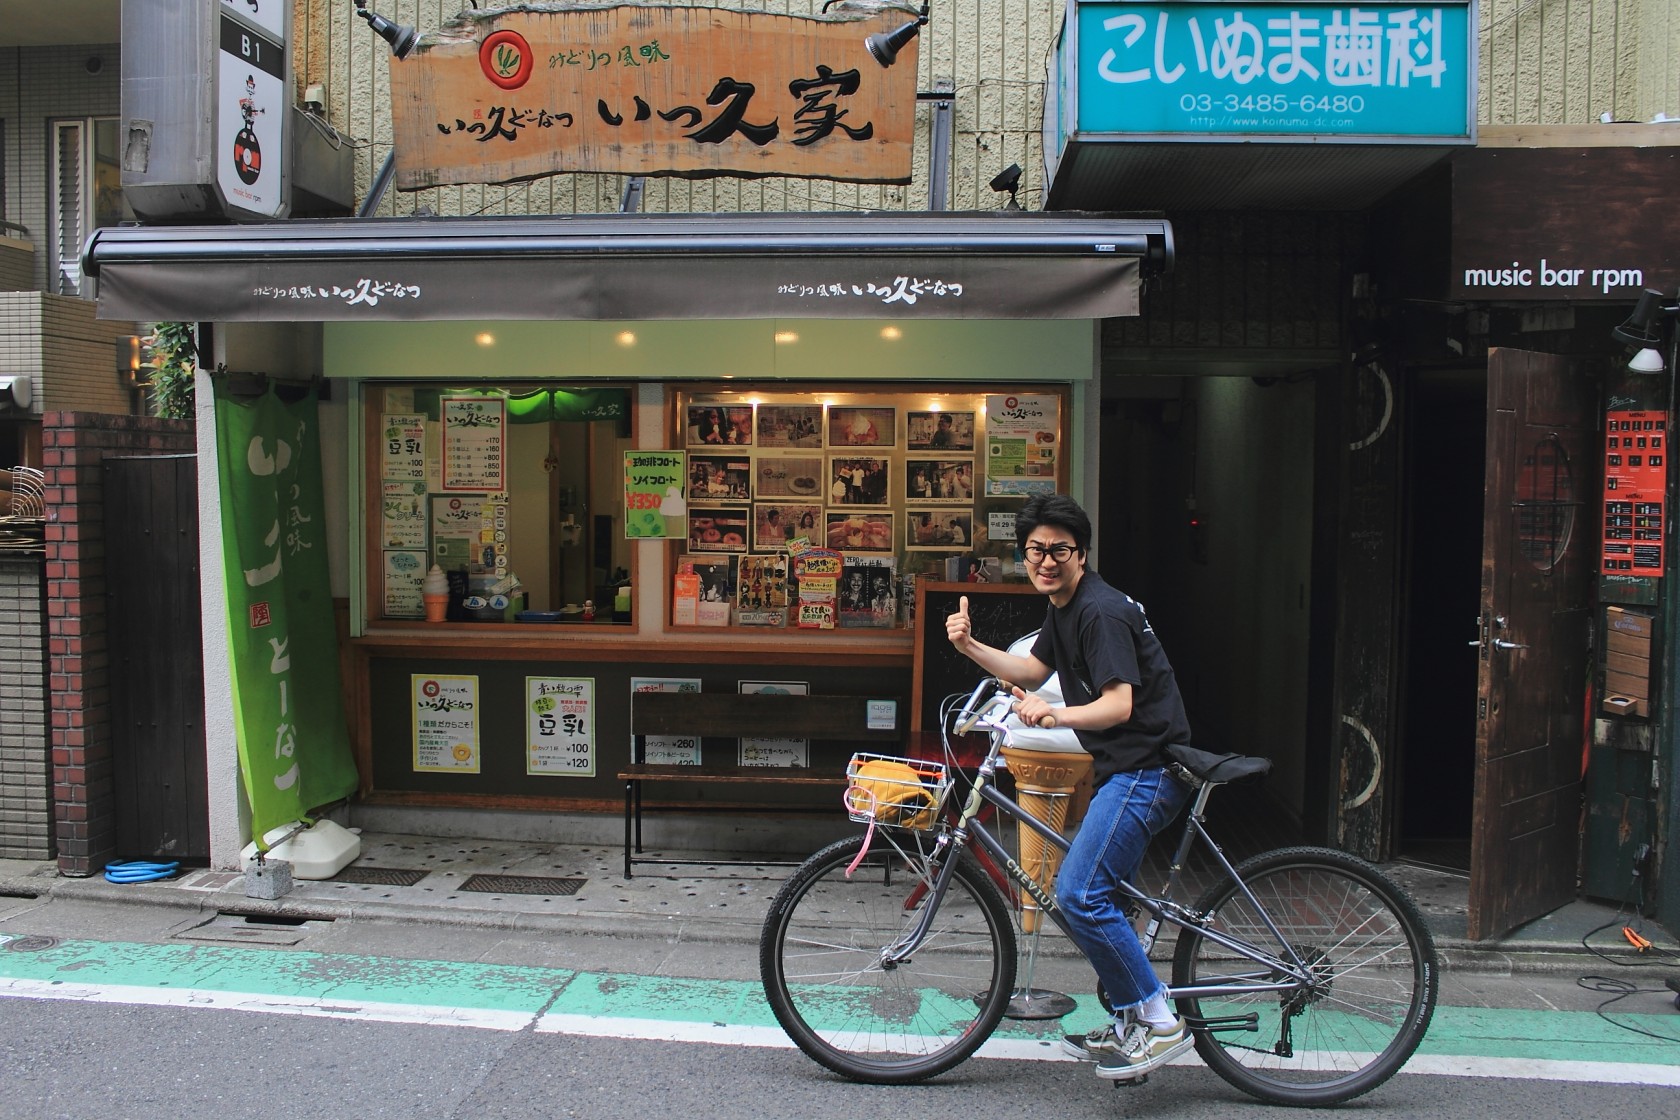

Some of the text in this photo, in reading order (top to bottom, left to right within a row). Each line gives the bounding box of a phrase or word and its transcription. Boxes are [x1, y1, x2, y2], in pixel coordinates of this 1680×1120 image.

[1098, 9, 1447, 88] こいぬま歯科
[1180, 94, 1364, 113] 03-3485-6480
[1190, 116, 1354, 128] http://www.koinuma-dc.com
[233, 188, 245, 198] music
[245, 189, 253, 200] bar
[1465, 259, 1642, 294] music bar rpm
[389, 439, 422, 455] 豆乳
[633, 456, 681, 467] 珈琲フロート
[633, 475, 677, 485] ソイフロート
[626, 491, 663, 510] ¥350
[539, 713, 586, 737] 豆乳
[566, 743, 589, 753] ¥100
[672, 739, 695, 749] ¥260
[566, 758, 589, 768] ¥120
